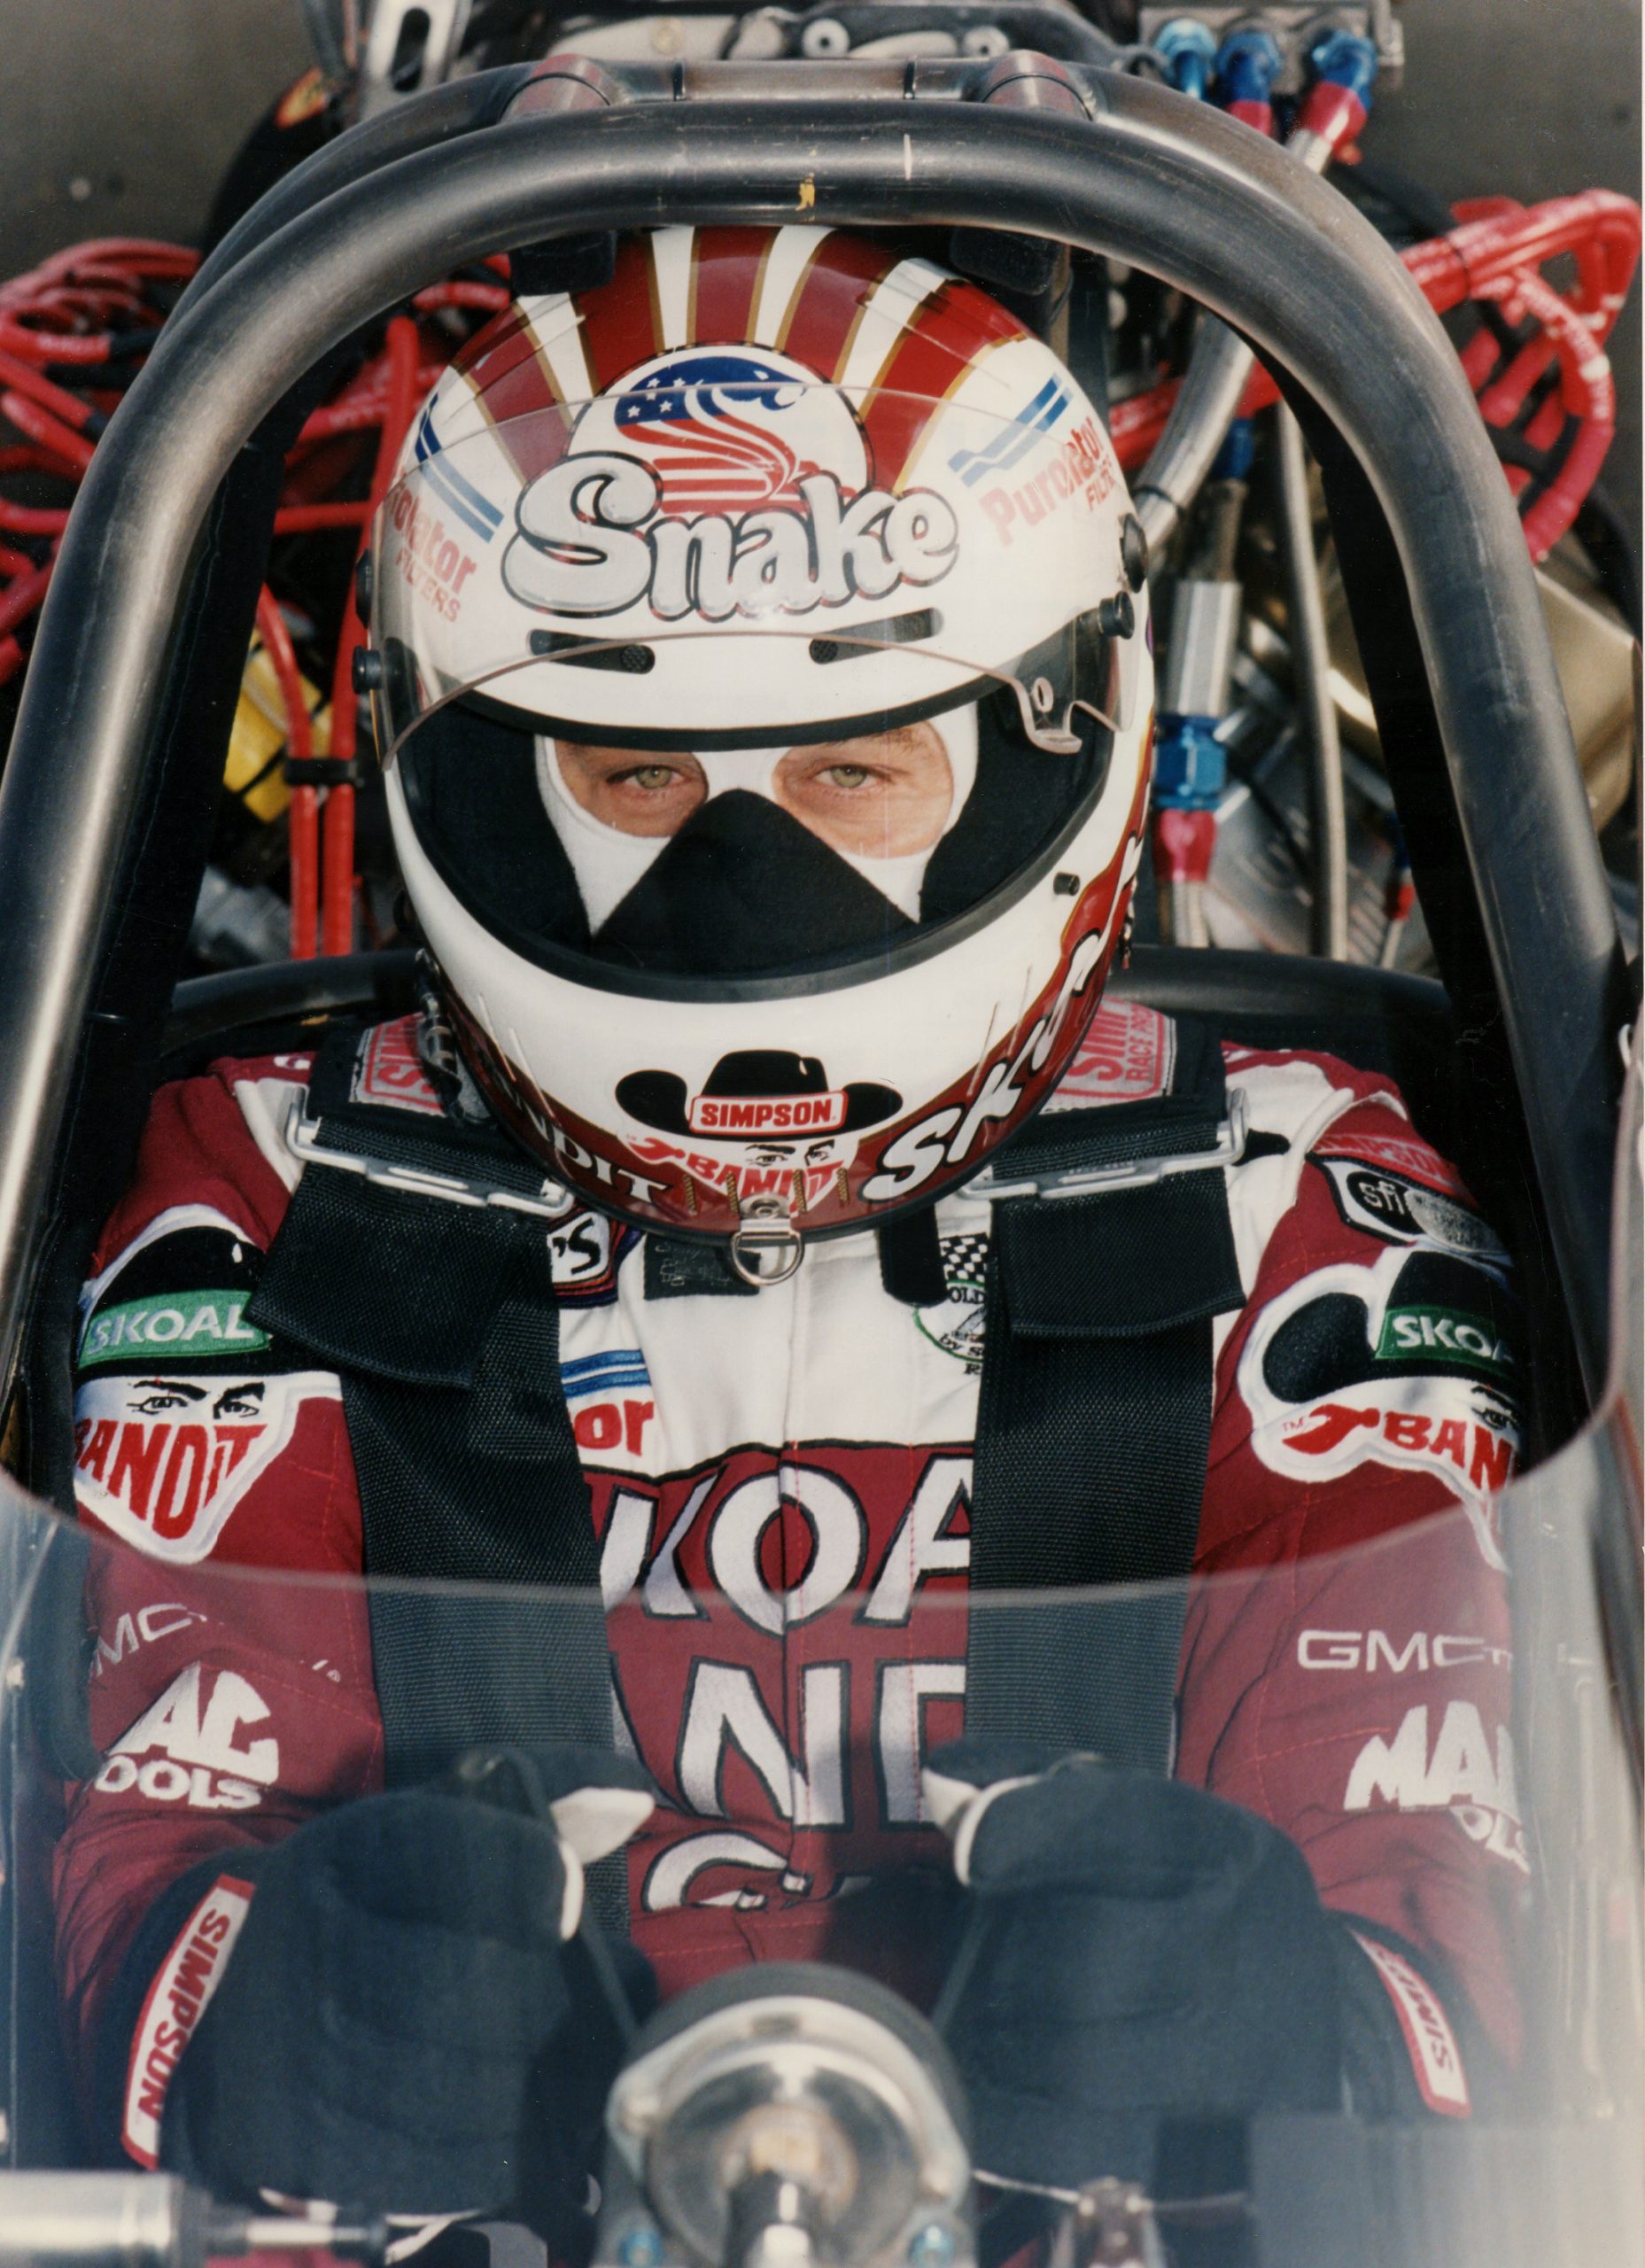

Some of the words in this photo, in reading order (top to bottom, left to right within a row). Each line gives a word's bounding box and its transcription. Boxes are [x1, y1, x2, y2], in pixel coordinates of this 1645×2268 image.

[501, 450, 959, 623] Snake
[1125, 1035, 1152, 1082] RACE
[701, 1099, 831, 1128] SIMPSON
[88, 1304, 255, 1355] SKOAL
[940, 1332, 963, 1350] by
[95, 1754, 262, 1810] OOLS
[137, 1908, 230, 2122] SIMPSON
